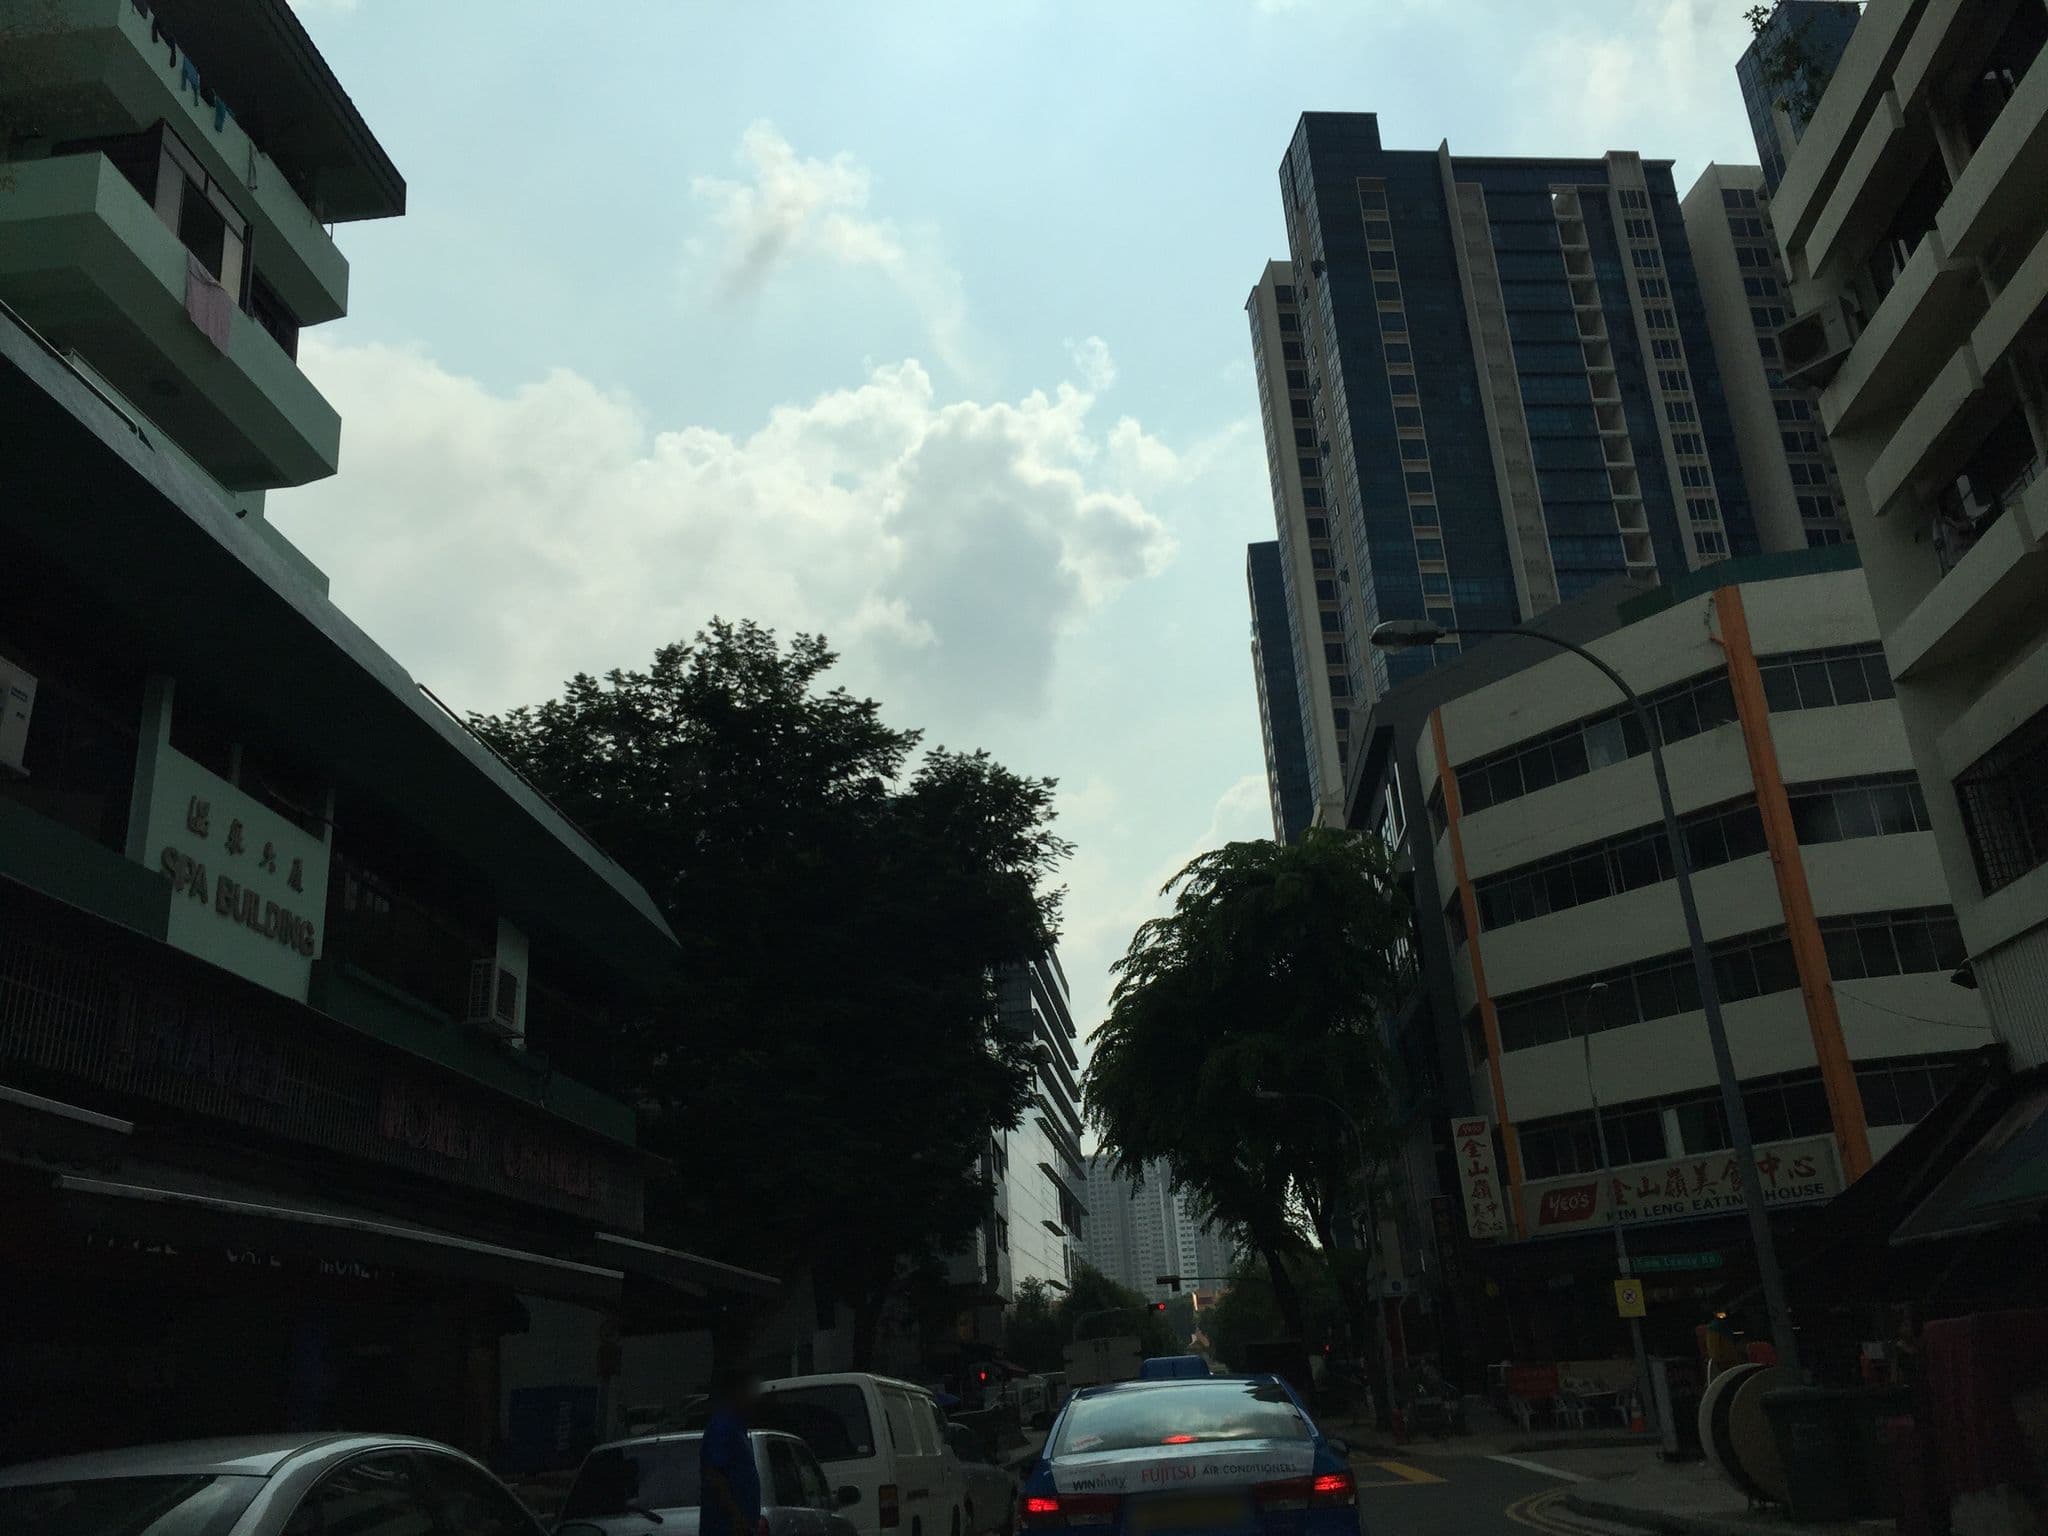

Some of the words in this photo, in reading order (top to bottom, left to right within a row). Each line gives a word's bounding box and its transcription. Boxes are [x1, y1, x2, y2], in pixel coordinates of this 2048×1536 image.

[161, 847, 208, 904] SPA
[215, 874, 315, 957] BUILDING
[1548, 1191, 1591, 1219] Yeo's
[1644, 1199, 1684, 1218] LENG
[1692, 1194, 1744, 1212] EATIN
[1764, 1182, 1824, 1201] HOUSE
[1141, 1465, 1196, 1484] FUJITSU
[1202, 1465, 1220, 1475] AIR
[1223, 1463, 1296, 1475] CONDITIONERS
